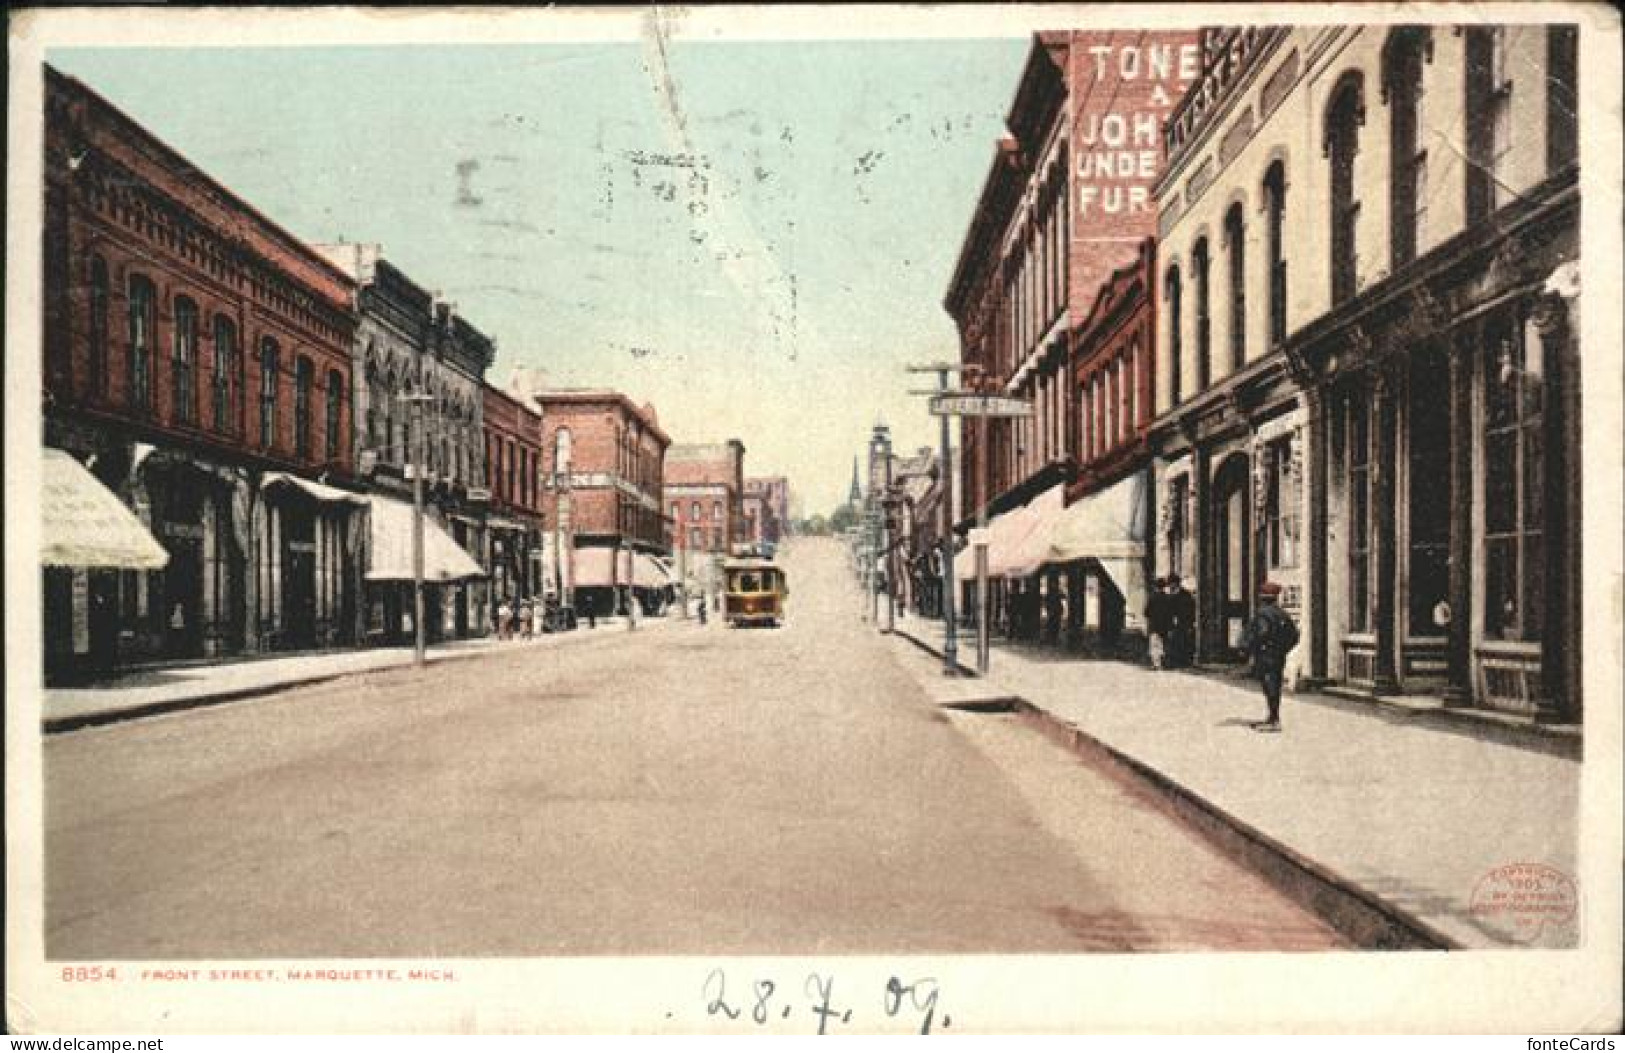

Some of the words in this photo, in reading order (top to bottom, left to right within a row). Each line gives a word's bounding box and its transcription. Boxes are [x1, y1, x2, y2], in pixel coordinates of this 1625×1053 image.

[1089, 44, 1200, 80] TONE
[1082, 112, 1169, 147] JOH
[1076, 151, 1157, 177] UNDE
[1079, 186, 1155, 217] FUR
